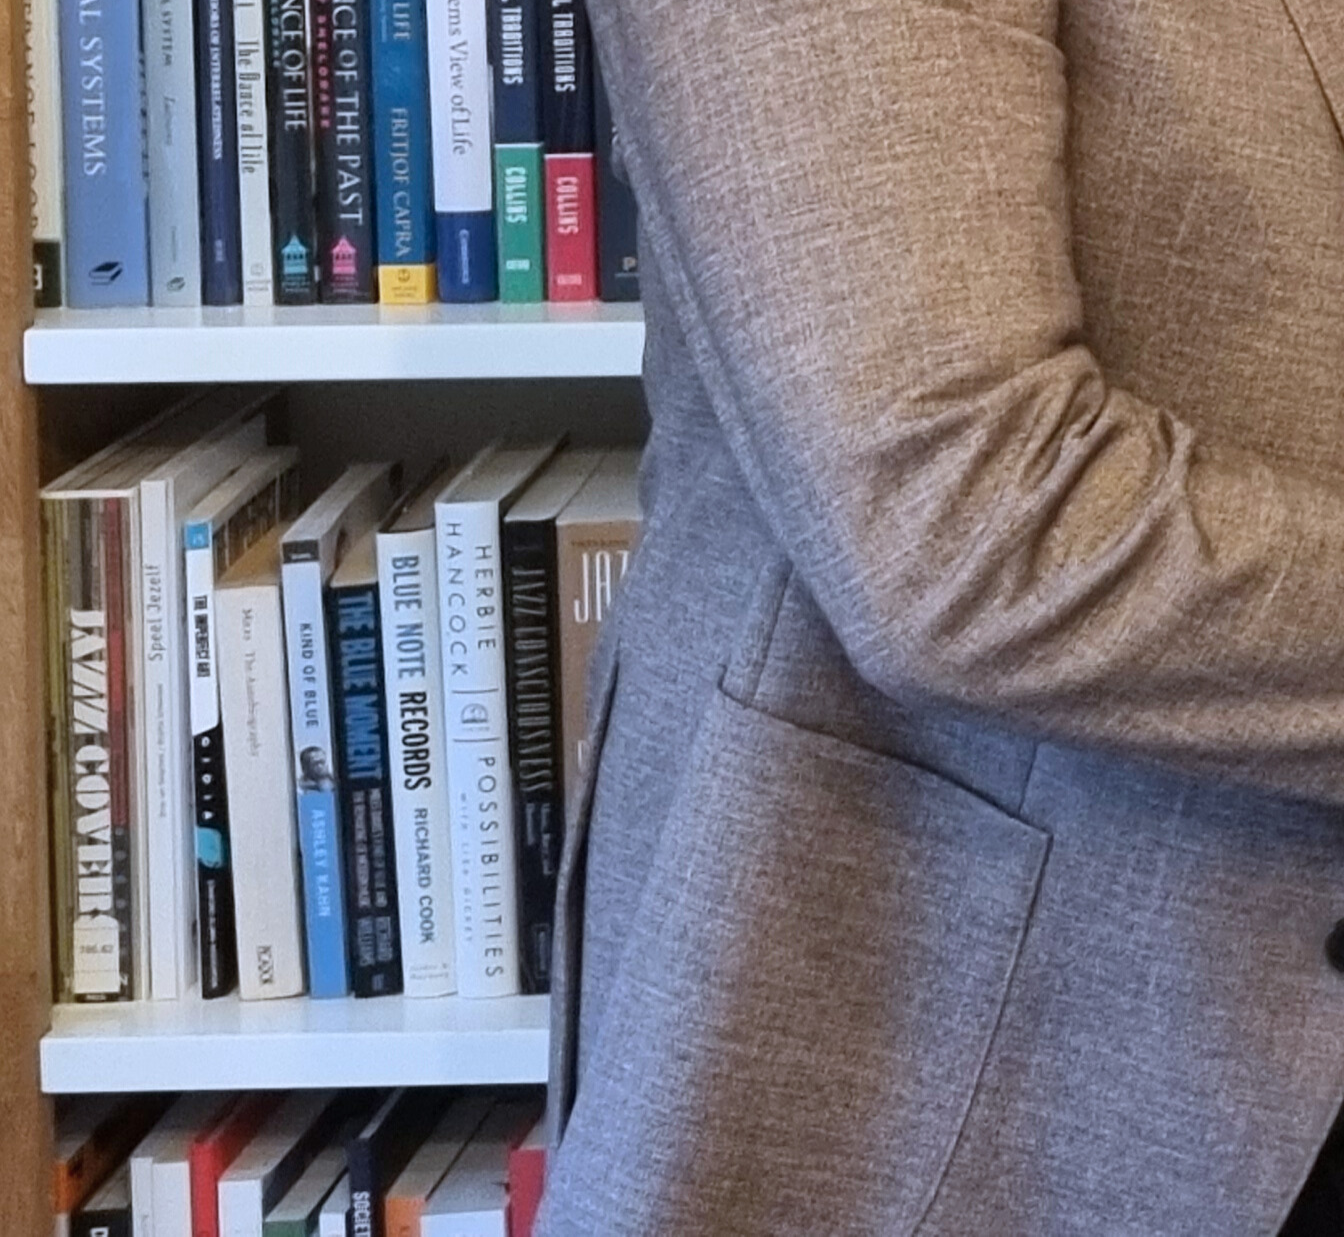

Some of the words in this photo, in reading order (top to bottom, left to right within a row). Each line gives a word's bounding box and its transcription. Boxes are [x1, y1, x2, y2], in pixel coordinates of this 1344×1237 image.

[392, 1, 412, 40] LIFE
[501, 7, 525, 84] TRADITIONS
[282, 49, 305, 83] OF
[335, 49, 356, 82] OF
[449, 41, 470, 87] View
[552, 13, 575, 92] TRADITIONS
[80, 36, 106, 176] SYSTEMS
[284, 88, 306, 131] LIFE
[336, 96, 359, 145] THE
[451, 94, 472, 116] of
[390, 107, 410, 186] FRITJOF
[452, 118, 473, 155] Life
[339, 155, 363, 227] PAST
[505, 167, 527, 223] COLLINS
[556, 176, 579, 235] COLLINS
[394, 191, 413, 257] CAPRA
[392, 555, 420, 610] BLUE
[446, 523, 467, 676] HANCOCK
[475, 545, 494, 650] HERBIE
[339, 591, 371, 633] THE
[300, 623, 315, 659] KIND
[341, 638, 374, 694] BLUE
[397, 624, 424, 679] NOTE
[70, 610, 109, 737] JAZZ
[302, 665, 316, 685] OF
[303, 689, 318, 727] BLUE
[346, 699, 381, 780] MOMENT
[400, 691, 430, 790] RECORDS
[414, 807, 431, 889] RICHARD
[478, 756, 503, 978] POSSIBILITIES
[419, 895, 435, 944] COOK
